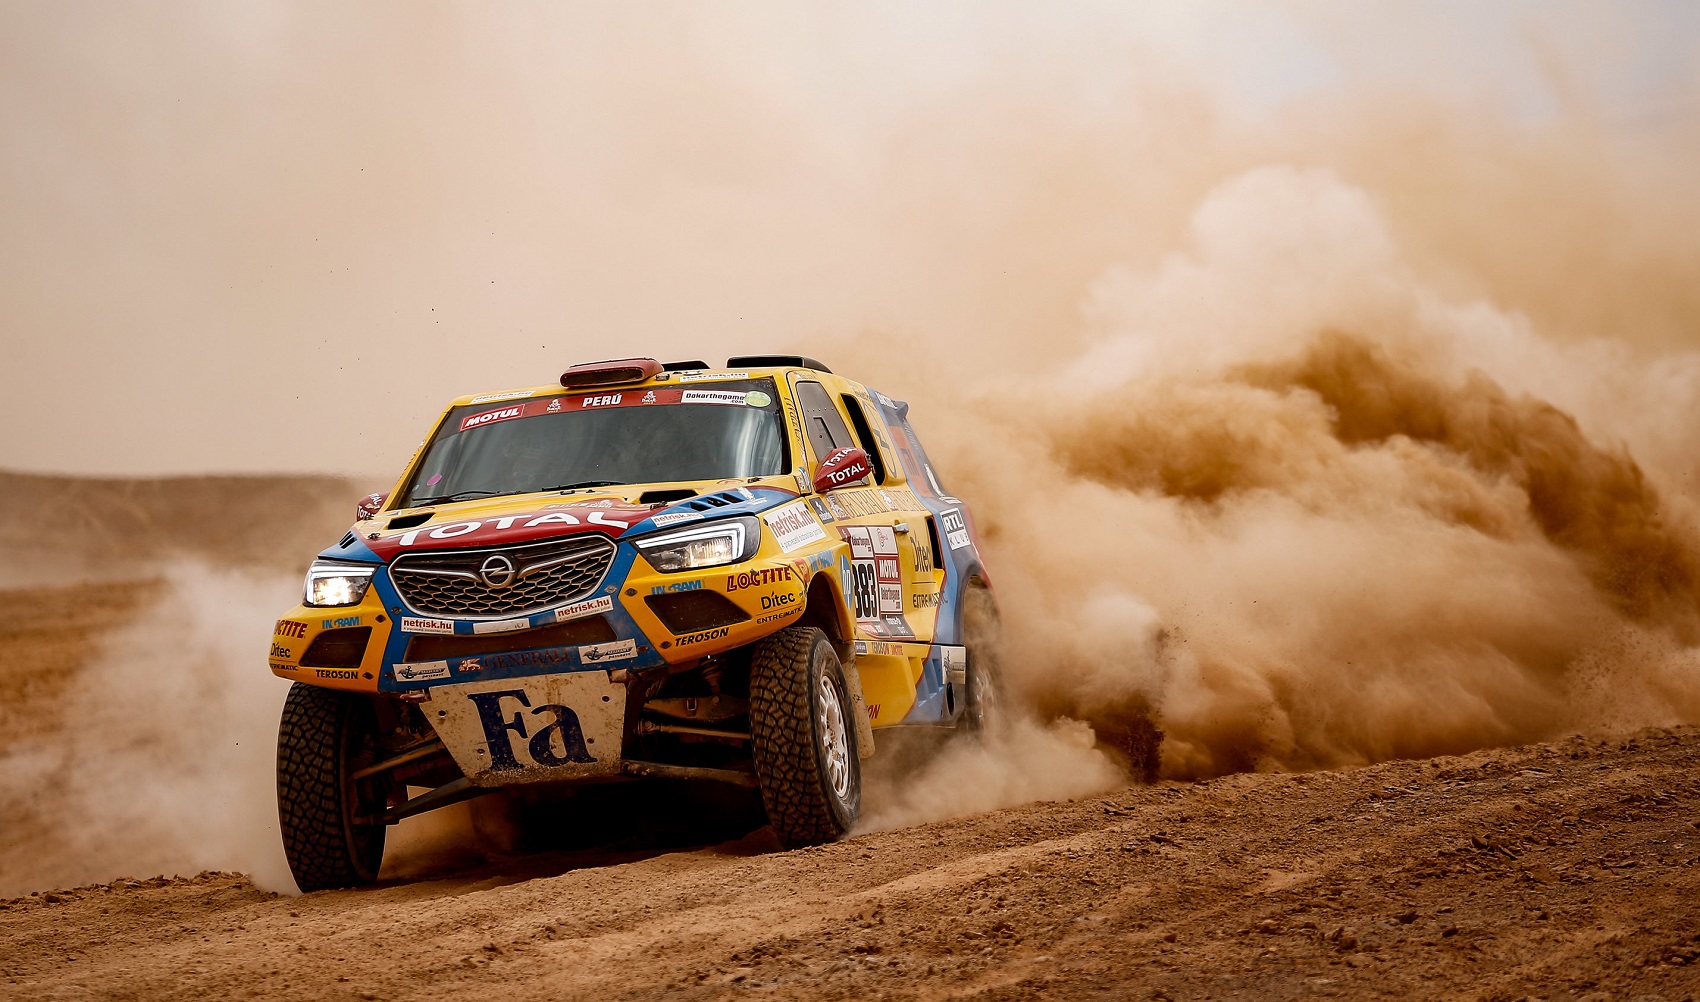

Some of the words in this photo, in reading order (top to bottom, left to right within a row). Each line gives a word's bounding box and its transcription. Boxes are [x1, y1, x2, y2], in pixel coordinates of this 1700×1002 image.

[582, 393, 622, 408] PERÚ
[464, 407, 520, 427] MOTUL
[827, 462, 865, 484] TOTAL
[388, 511, 629, 546] TOTAL
[769, 506, 815, 539] netrisk.hu
[943, 513, 963, 531] RTL
[726, 567, 792, 592] LOCTITE
[557, 598, 611, 617] netrisk.hu
[403, 619, 453, 630] netrisk.hu
[675, 627, 730, 647] TEROSON
[315, 669, 359, 680] TEROSON
[466, 689, 598, 772] Fa
